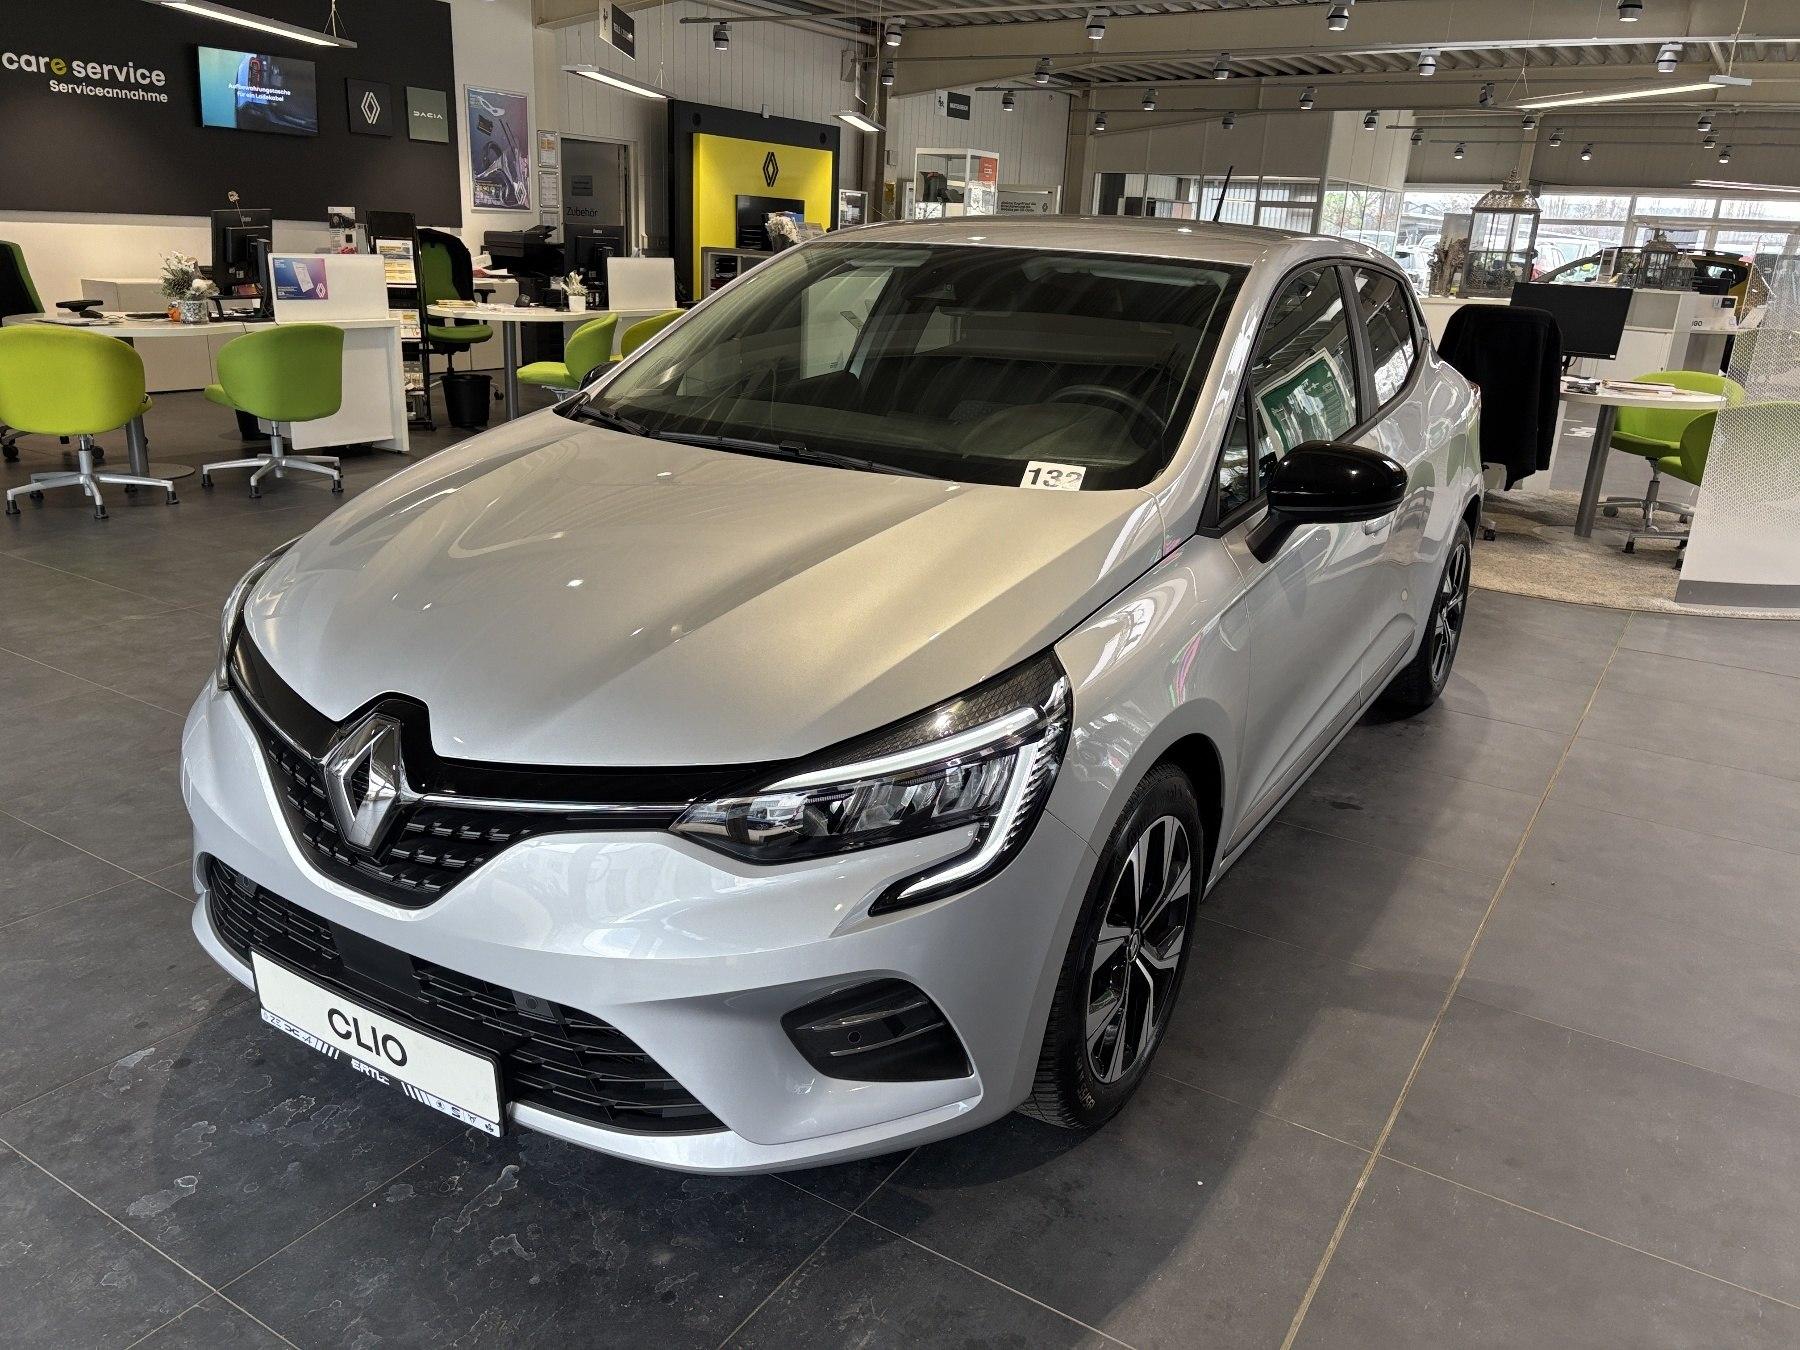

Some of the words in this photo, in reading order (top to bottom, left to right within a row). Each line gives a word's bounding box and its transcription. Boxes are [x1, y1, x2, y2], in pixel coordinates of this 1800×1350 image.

[1, 51, 67, 75] care
[71, 61, 166, 87] service
[49, 79, 168, 103] Serviceannahme
[413, 110, 443, 120] DACIA
[327, 1008, 408, 1067] CLIO
